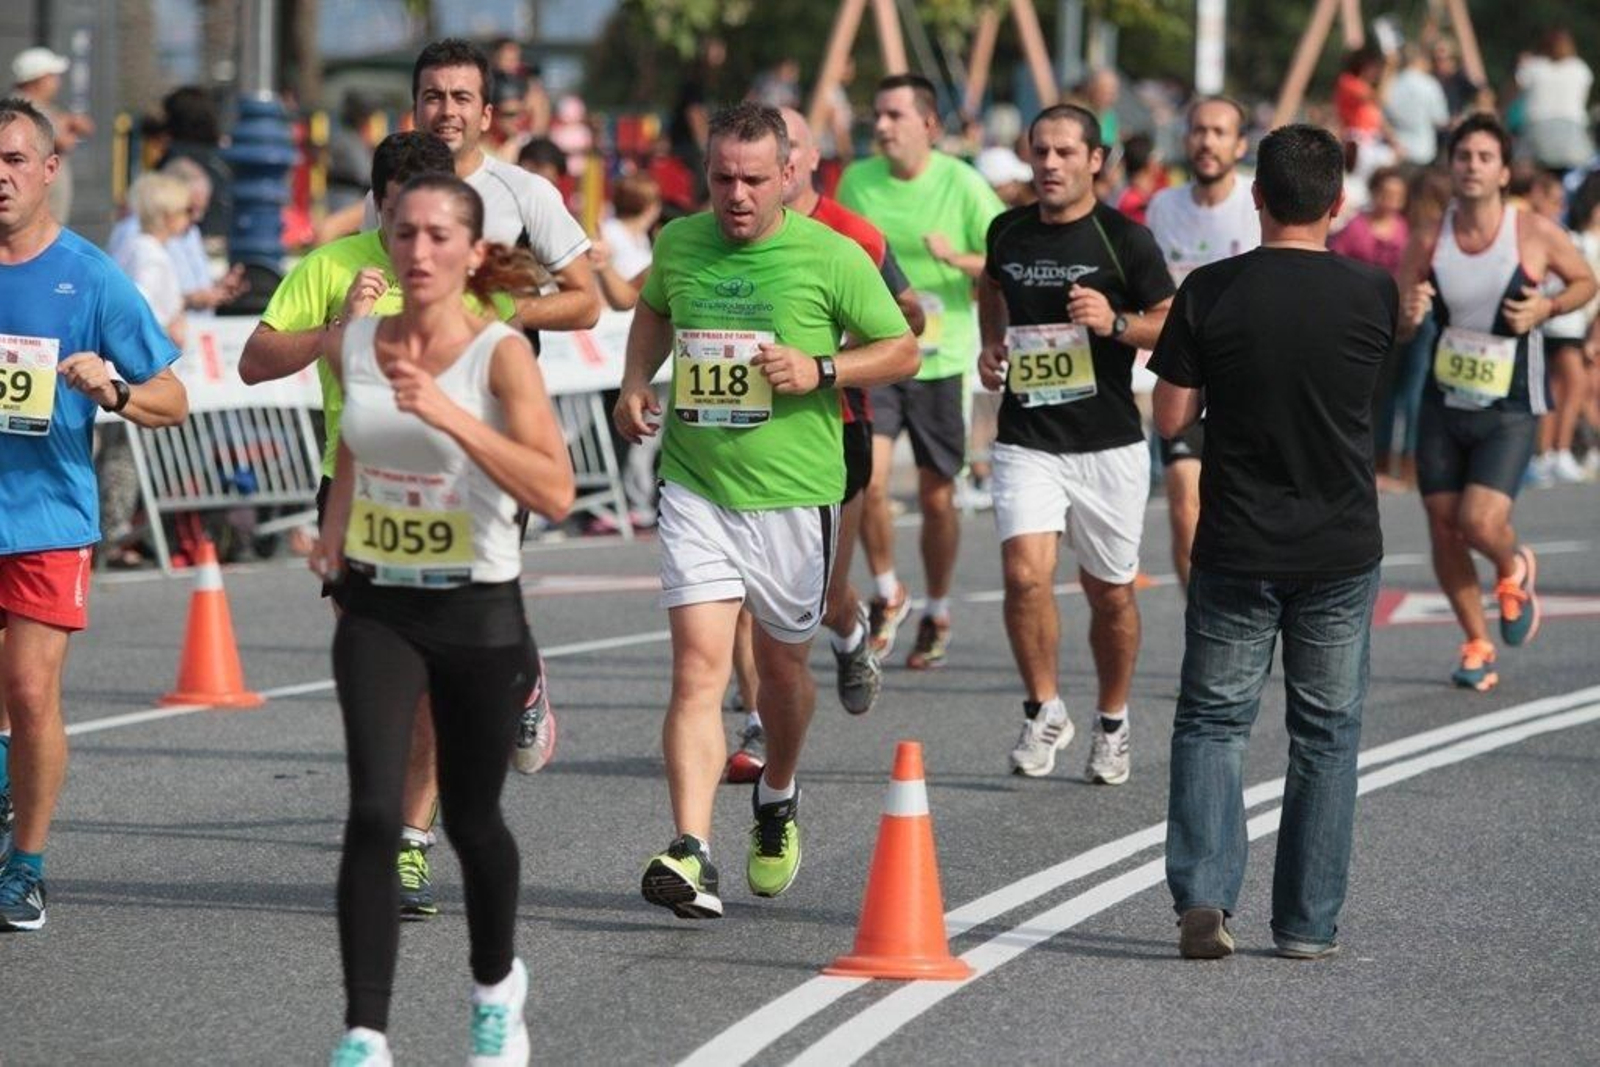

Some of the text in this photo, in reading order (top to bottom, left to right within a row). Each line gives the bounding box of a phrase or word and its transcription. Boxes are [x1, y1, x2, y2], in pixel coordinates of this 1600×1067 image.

[690, 364, 749, 396] 118
[1019, 352, 1073, 381] 550
[1449, 354, 1495, 383] 938
[362, 512, 453, 554] 1059
